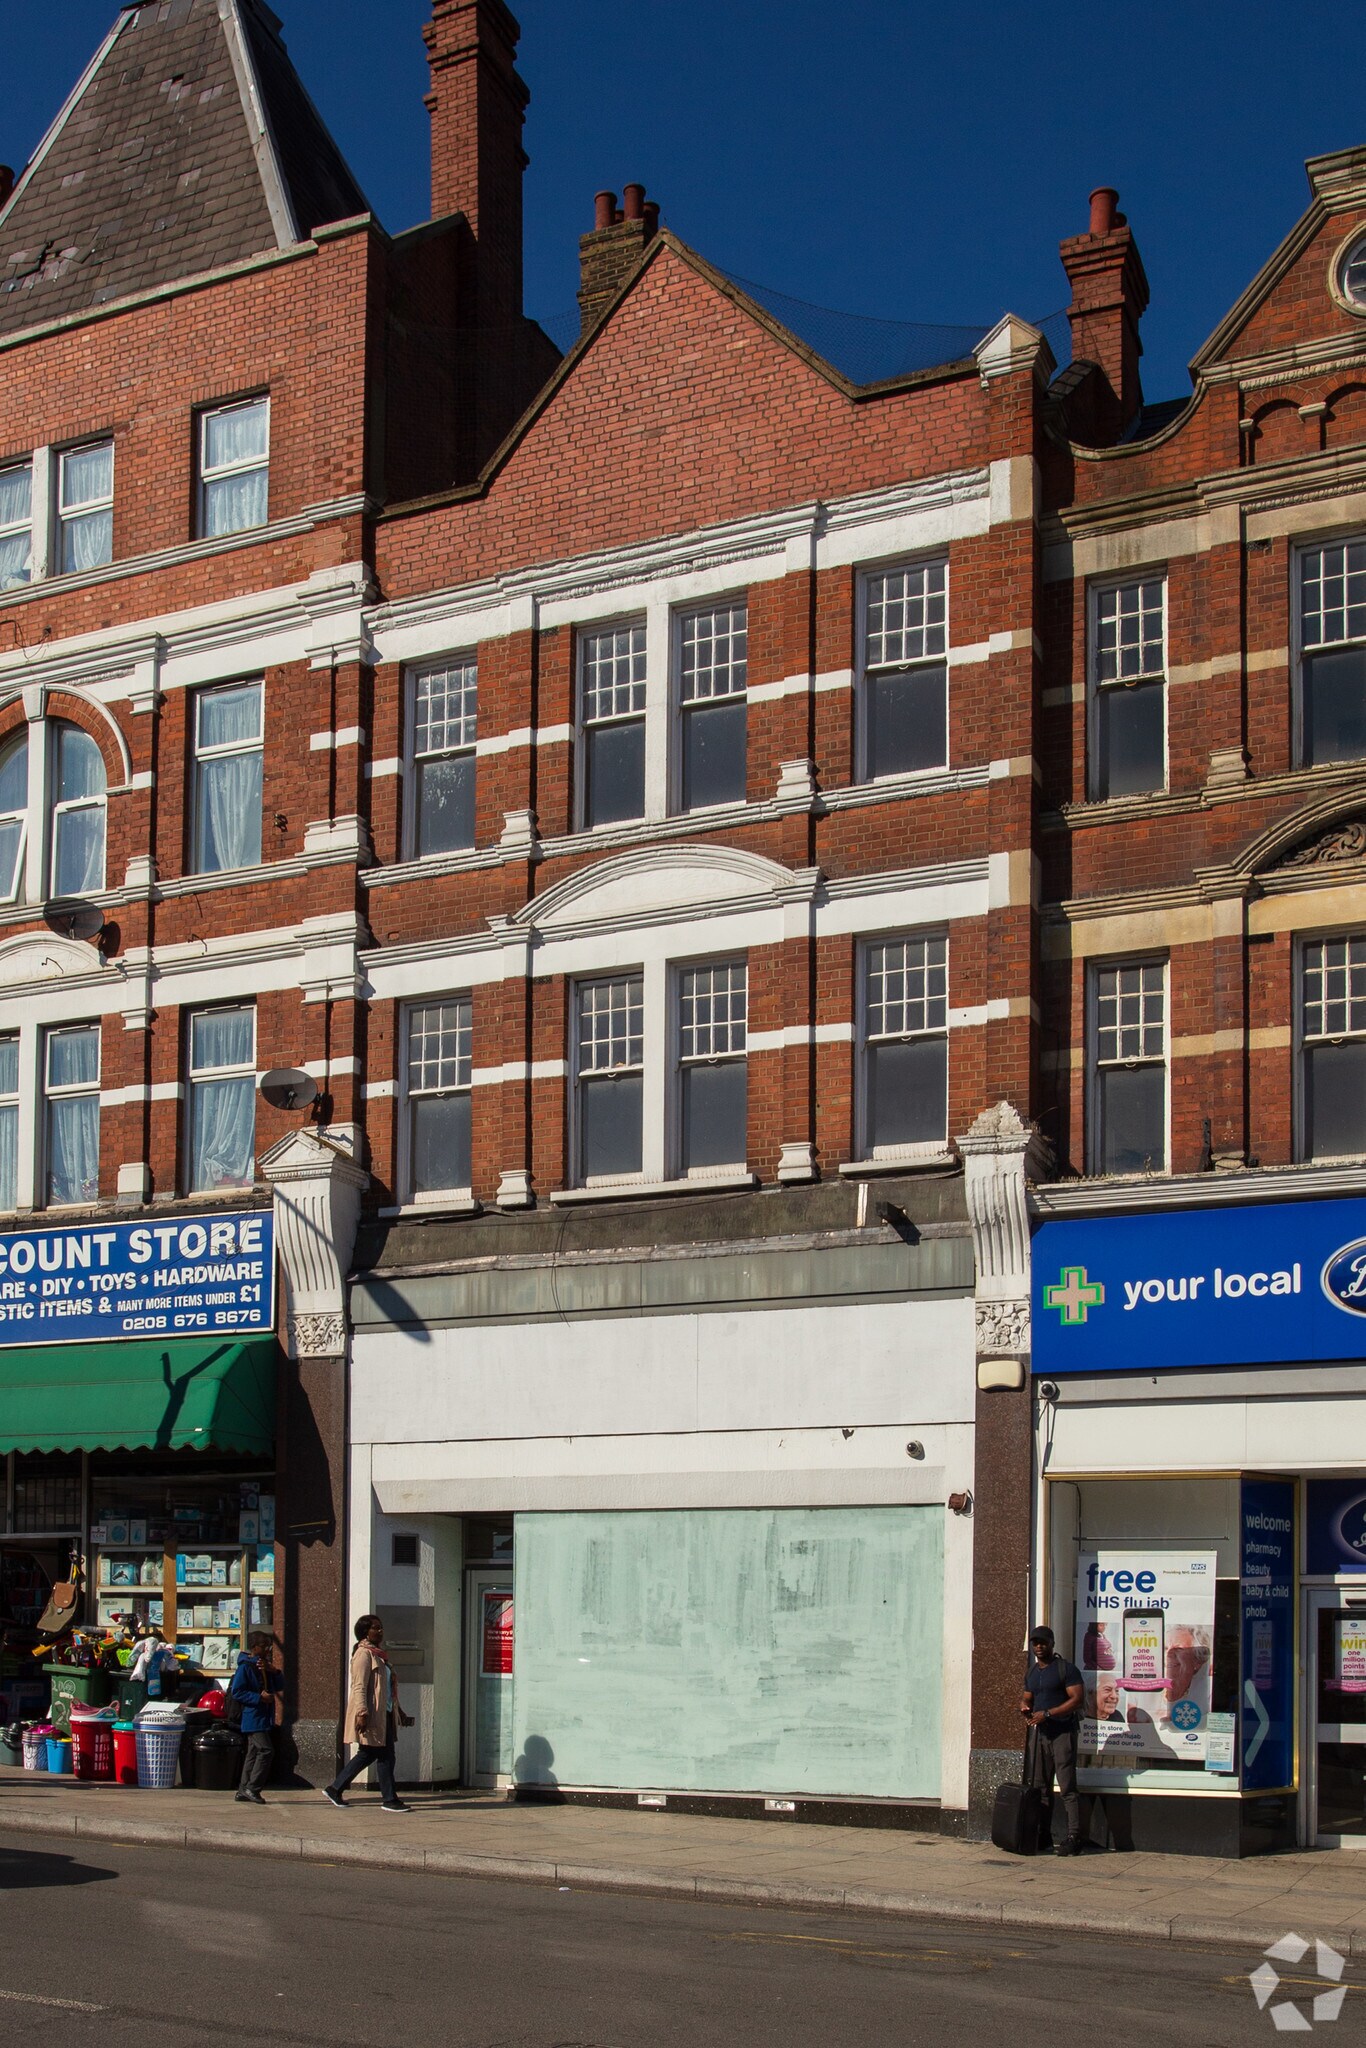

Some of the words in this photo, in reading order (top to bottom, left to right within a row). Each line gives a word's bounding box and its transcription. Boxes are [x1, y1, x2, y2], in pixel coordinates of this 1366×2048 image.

[128, 1218, 262, 1263] STORE
[0, 1281, 26, 1299] RE
[42, 1277, 73, 1296] DIY
[89, 1272, 137, 1292] TOYS
[153, 1261, 263, 1287] HARDWARE
[1123, 1276, 1204, 1311] your
[1214, 1263, 1301, 1298] local
[40, 1298, 93, 1318] ITEMS
[98, 1297, 112, 1313] &
[117, 1299, 143, 1313] MANY
[145, 1297, 171, 1310] MORE
[175, 1295, 202, 1308] ITEMS
[206, 1292, 236, 1305] UNDER
[240, 1284, 261, 1303] £1
[122, 1316, 167, 1331] 0208
[174, 1313, 207, 1327] 676
[214, 1309, 261, 1324] 8676
[1246, 1512, 1291, 1532] welcome
[1246, 1541, 1281, 1558] pharmacy
[1086, 1562, 1156, 1593] free
[1246, 1562, 1271, 1577] beauty
[1246, 1583, 1263, 1598] baby
[1265, 1585, 1270, 1597] &
[1271, 1585, 1289, 1597] child
[1086, 1596, 1120, 1608] NHS
[1124, 1596, 1142, 1608] flu
[1245, 1605, 1267, 1619] photo
[1130, 1633, 1157, 1647] win
[1340, 1635, 1366, 1649] win
